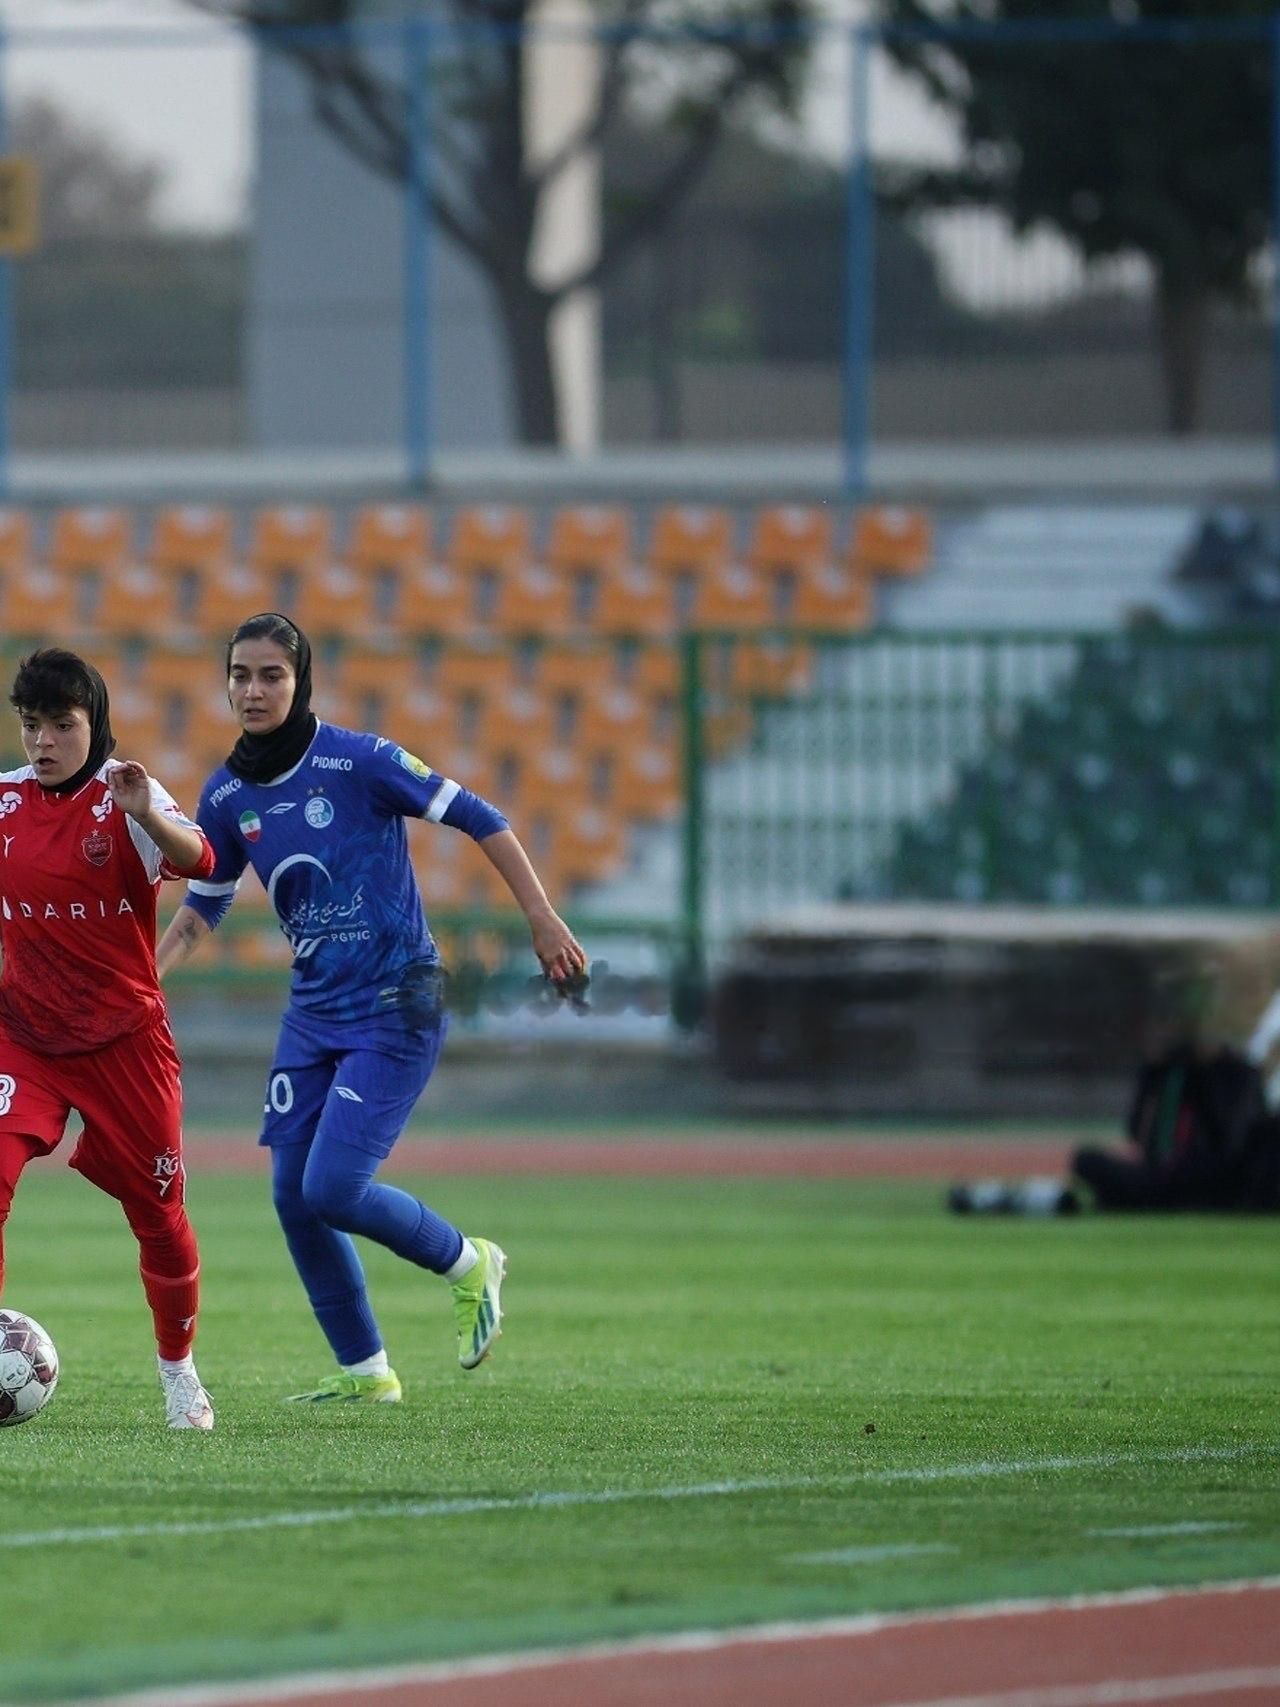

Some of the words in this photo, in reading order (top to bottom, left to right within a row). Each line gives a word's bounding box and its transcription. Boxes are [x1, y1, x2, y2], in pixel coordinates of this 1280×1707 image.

[311, 755, 354, 771] PIDMCO
[209, 778, 242, 808] PIDMCO
[20, 898, 133, 920] DARIA
[330, 930, 371, 943] PGPIC
[264, 1073, 294, 1114] 0
